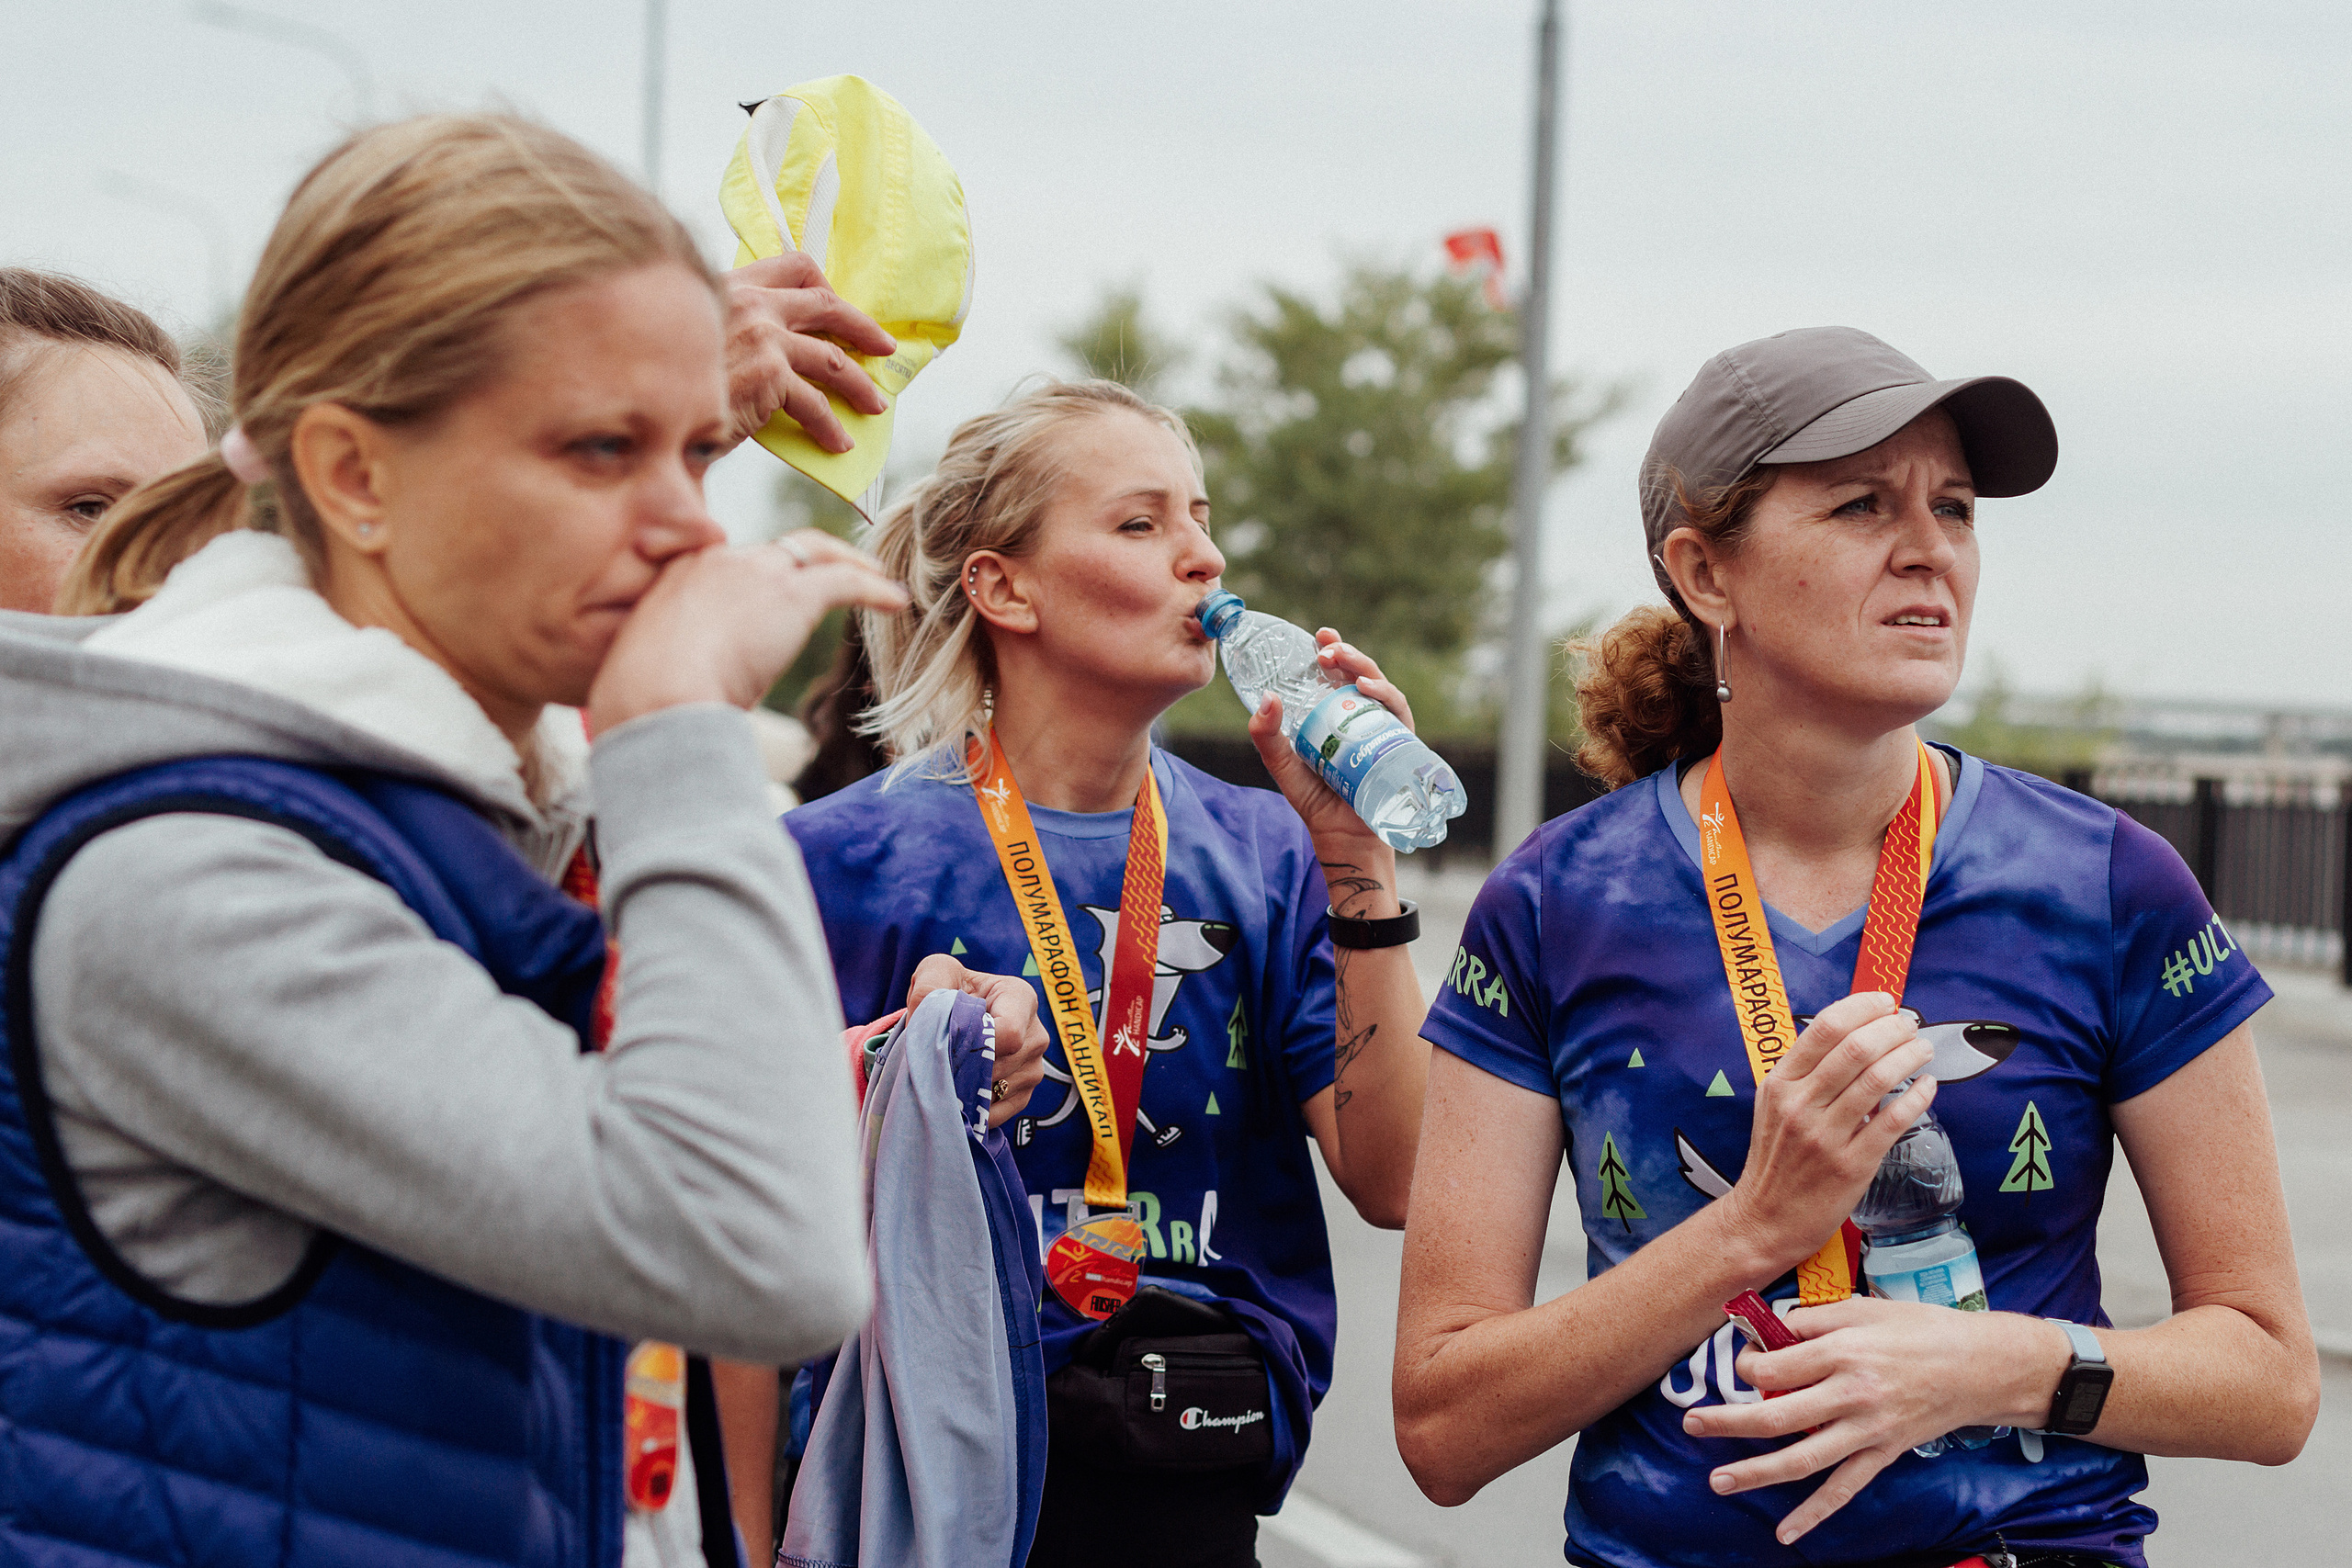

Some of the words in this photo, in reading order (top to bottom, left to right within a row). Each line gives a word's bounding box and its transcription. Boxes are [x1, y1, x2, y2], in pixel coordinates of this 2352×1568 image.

[1705, 829, 1717, 865] HANDICAP
[1007, 840, 1080, 1013] ПОЛУМАРАФОН
[1065, 1021, 1114, 1138] ГАНДИКАП
[1132, 995, 1144, 1035] HANDICAP
[1179, 1406, 1265, 1435] Champion
